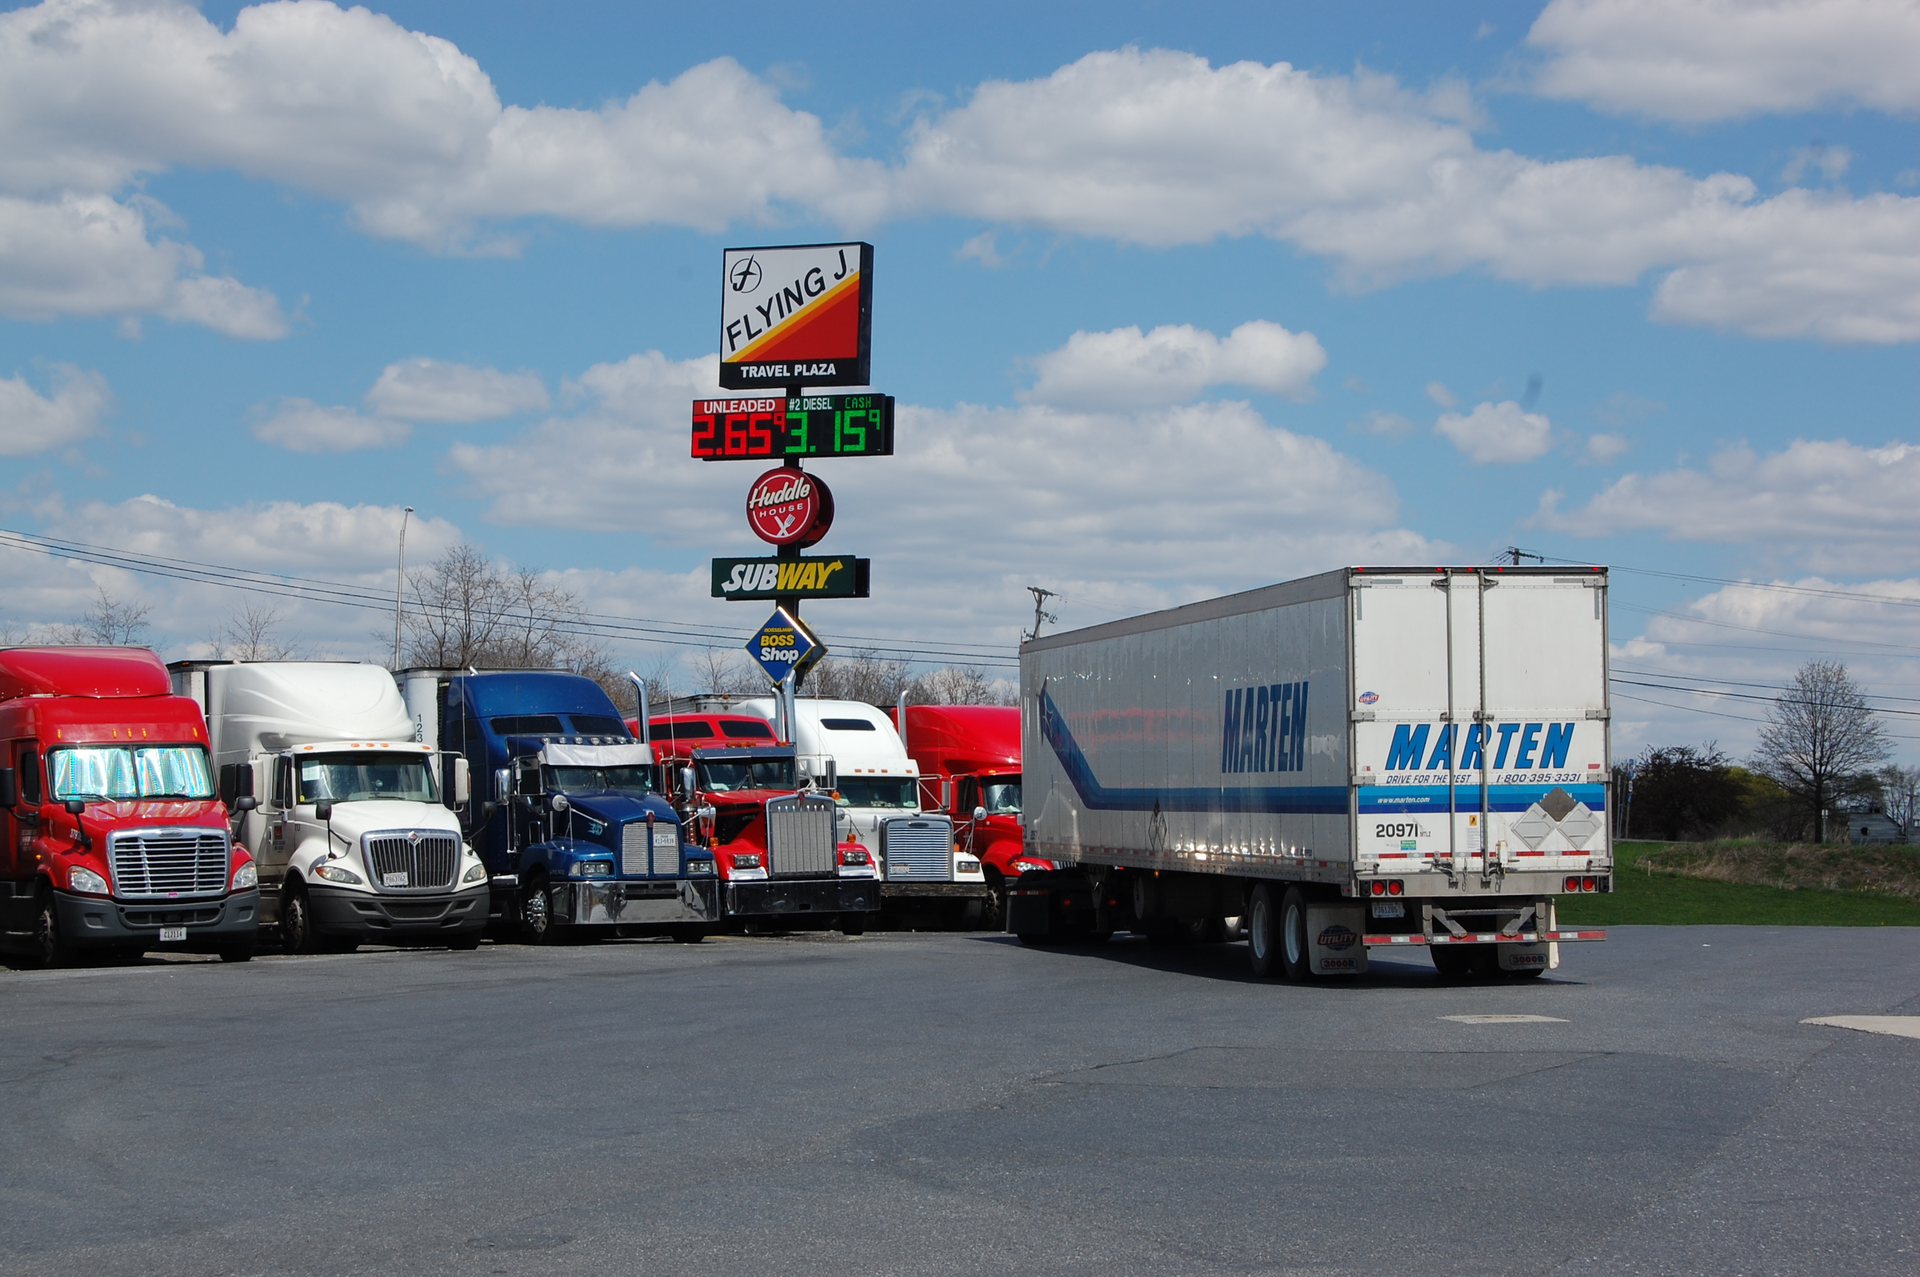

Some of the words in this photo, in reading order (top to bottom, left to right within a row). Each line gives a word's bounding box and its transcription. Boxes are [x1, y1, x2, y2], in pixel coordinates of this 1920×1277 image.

[726, 267, 826, 351] FLYING
[834, 249, 847, 281] J
[740, 364, 790, 378] TRAVEL
[794, 363, 836, 377] PLAZA
[704, 399, 776, 414] UNLEADED
[789, 398, 801, 411] #2
[803, 397, 832, 410] DIESEL
[844, 396, 872, 409] CASH
[749, 477, 811, 509] Huddle
[759, 502, 804, 518] HOUSE
[721, 560, 843, 593] SUBWAY
[760, 634, 795, 646] BOSS
[760, 646, 799, 664] Shop
[1221, 681, 1309, 774] MARTEN
[1385, 722, 1576, 771] MARTEN
[1386, 774, 1411, 784] DRIVE
[1413, 773, 1430, 783] FOR
[1432, 773, 1447, 783] THE
[1377, 796, 1431, 804] www.marten.com
[1376, 823, 1418, 838] 20971
[1320, 933, 1355, 945] UTILITY
[1323, 959, 1355, 968] 3000R
[1512, 955, 1544, 964] 3000R
